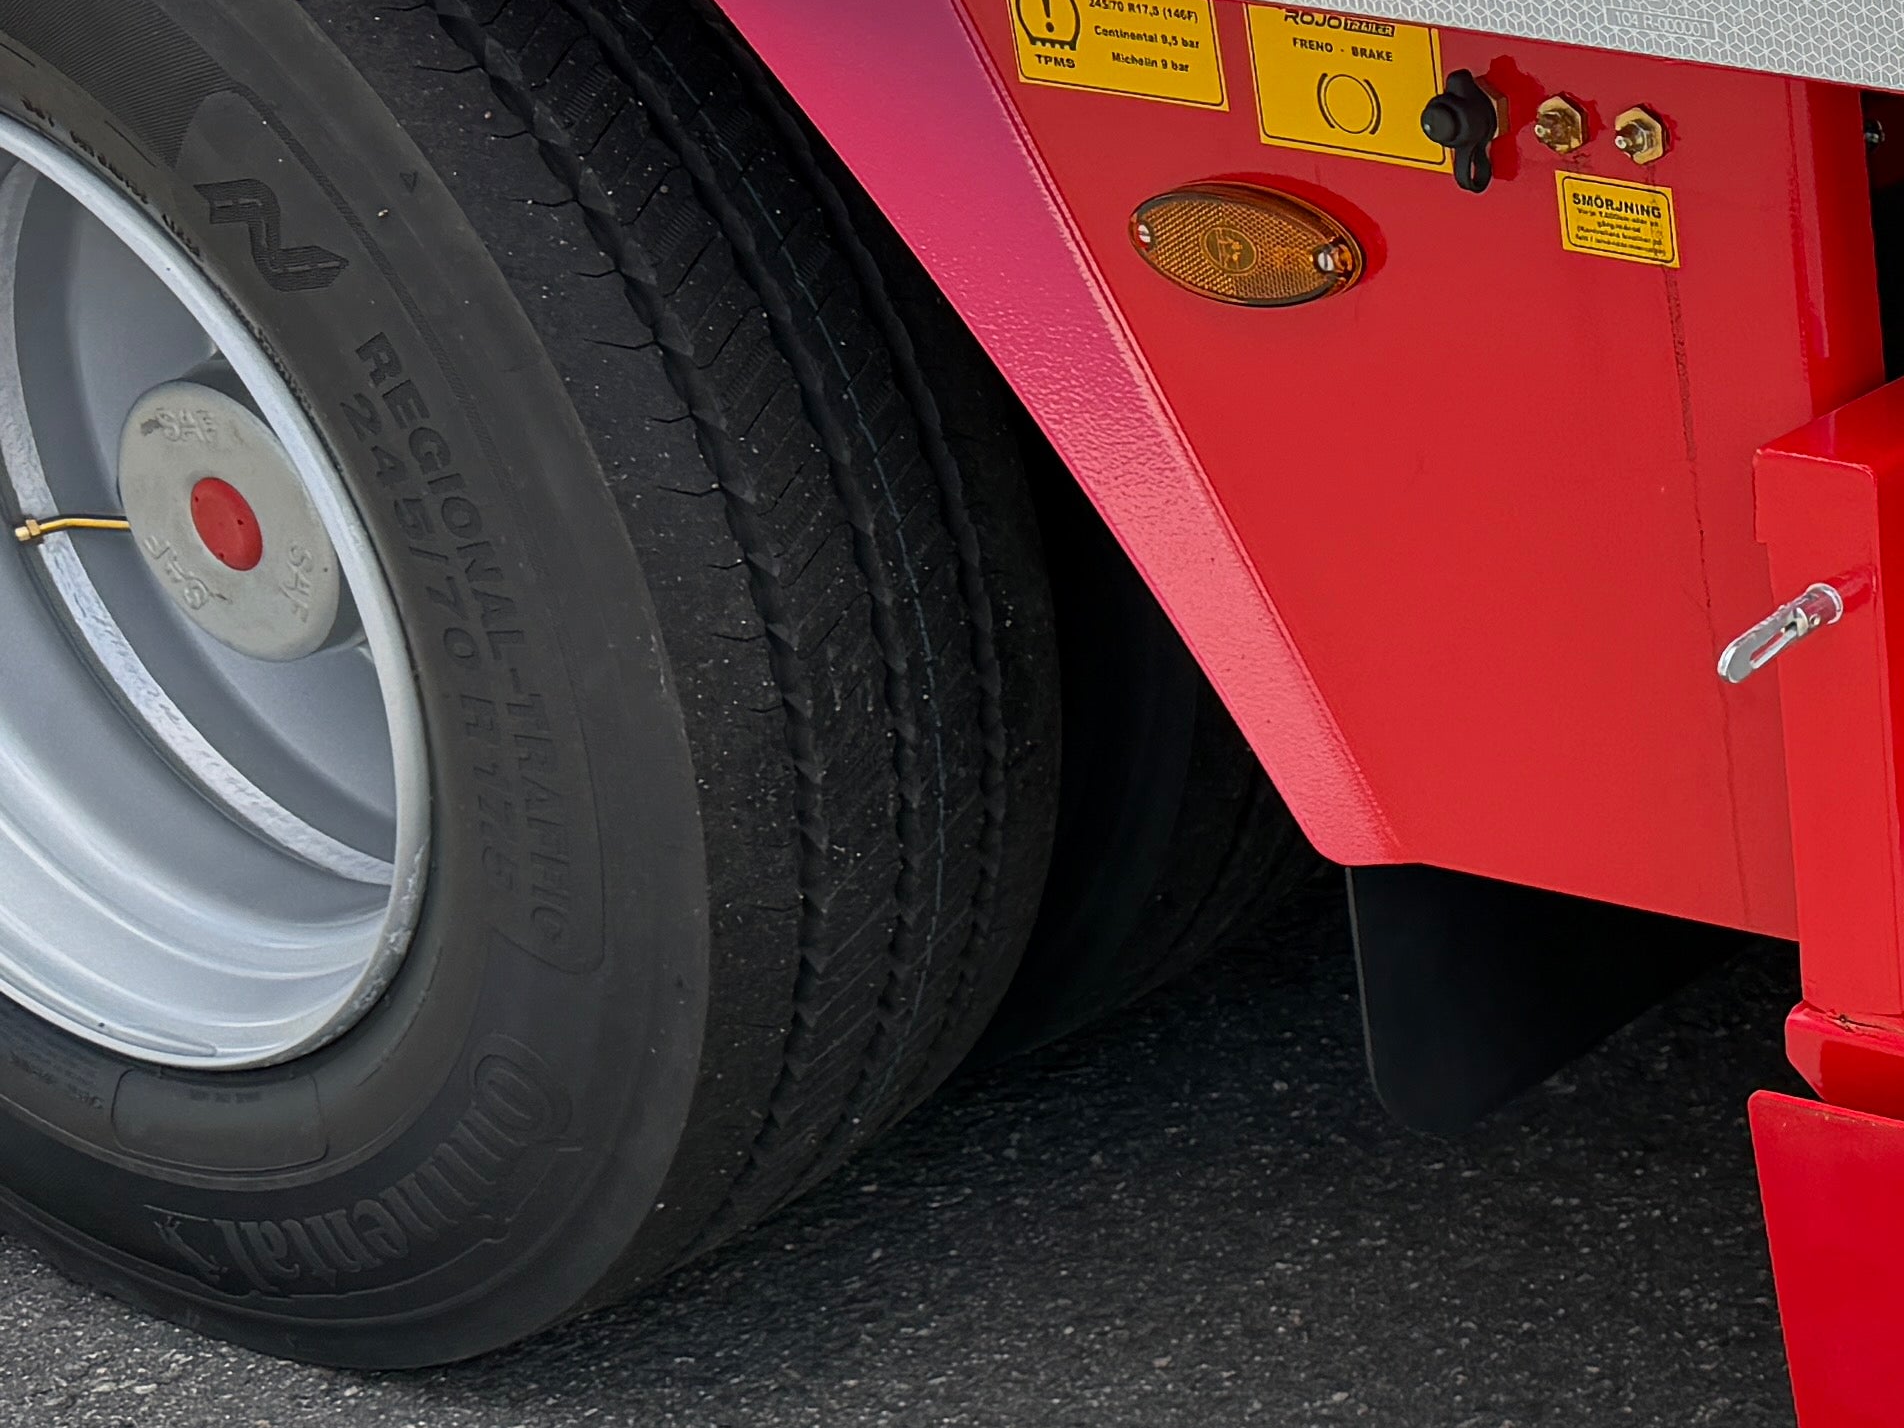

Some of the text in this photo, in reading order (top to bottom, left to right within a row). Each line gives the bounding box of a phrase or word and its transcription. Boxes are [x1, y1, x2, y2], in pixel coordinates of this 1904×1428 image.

[1284, 8, 1394, 36] ROJO TRAILER
[1093, 25, 1158, 44] Continental
[1181, 36, 1200, 49] bar
[1034, 53, 1076, 69] TPMS
[1292, 37, 1334, 53] FRENO
[1351, 46, 1394, 62] BRAKE
[1111, 51, 1158, 68] Michelin
[1171, 61, 1190, 73] bar
[1572, 192, 1662, 220] SMÖRJNING
